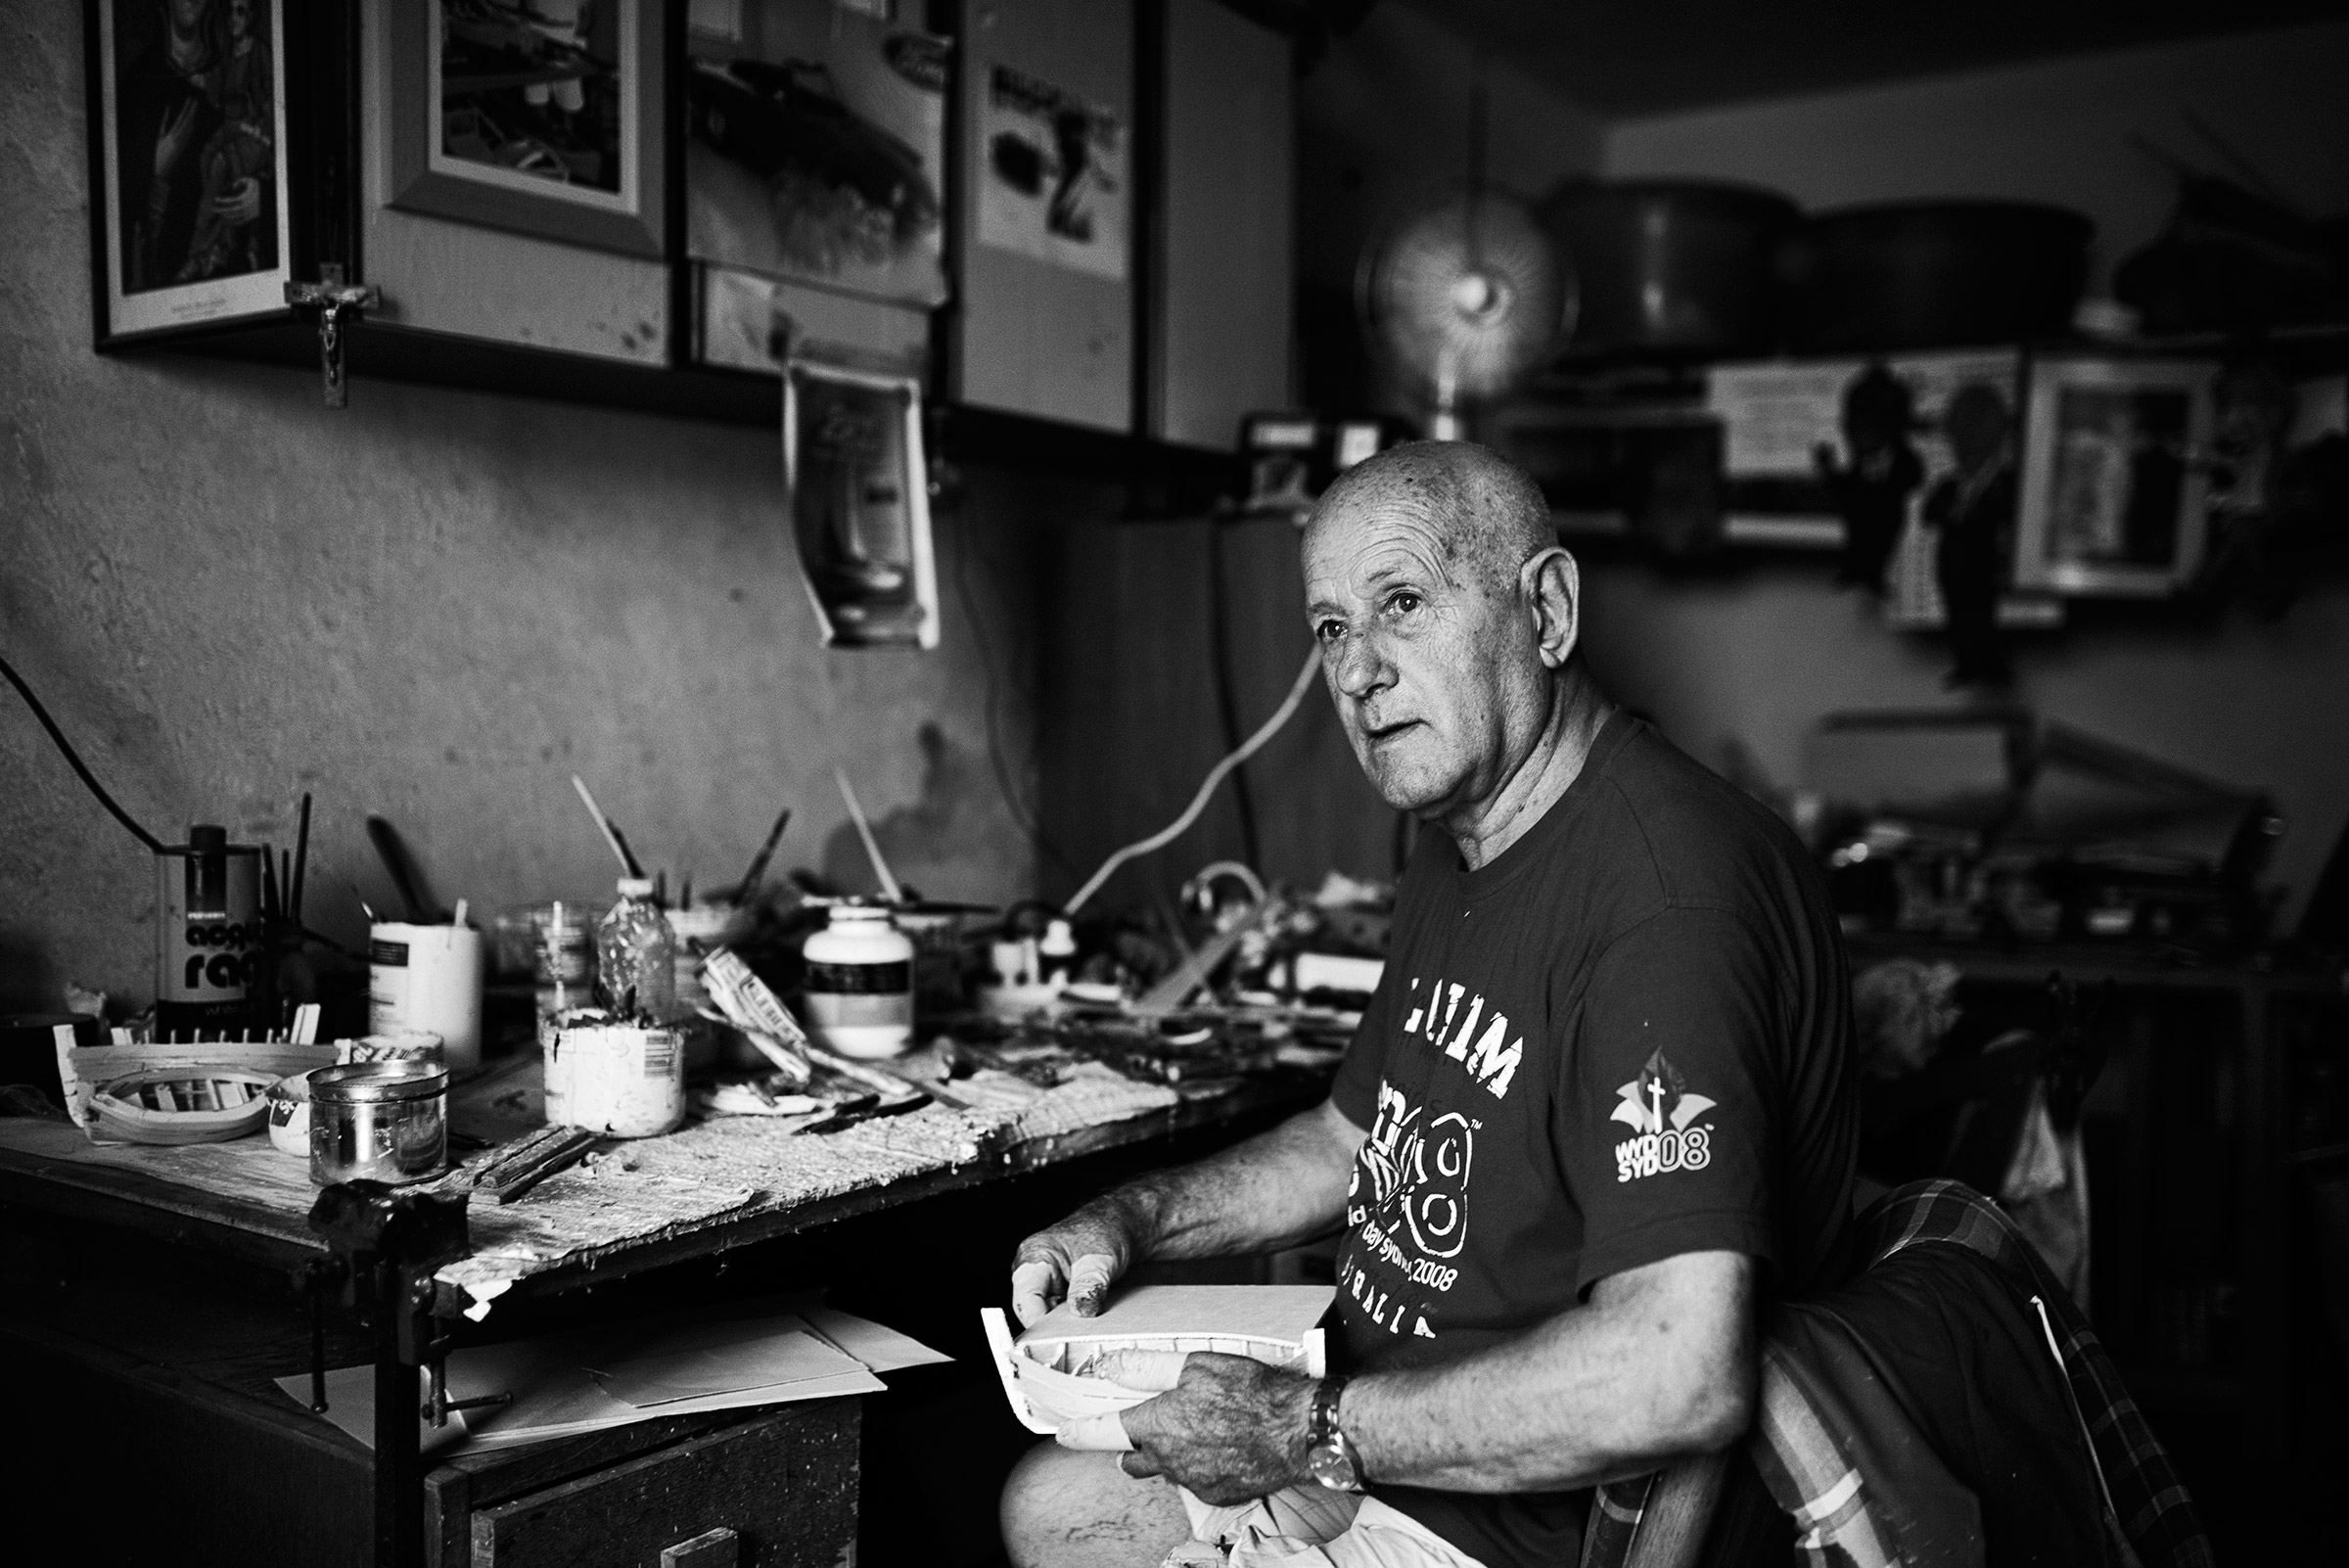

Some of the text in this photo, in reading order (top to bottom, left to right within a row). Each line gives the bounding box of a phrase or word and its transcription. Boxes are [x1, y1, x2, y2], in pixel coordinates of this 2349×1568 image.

[1615, 1134, 1659, 1164] WYD
[1617, 1127, 1711, 1182] SYD 08
[1362, 1220, 1385, 1251] day
[1412, 1258, 1458, 1292] 2008
